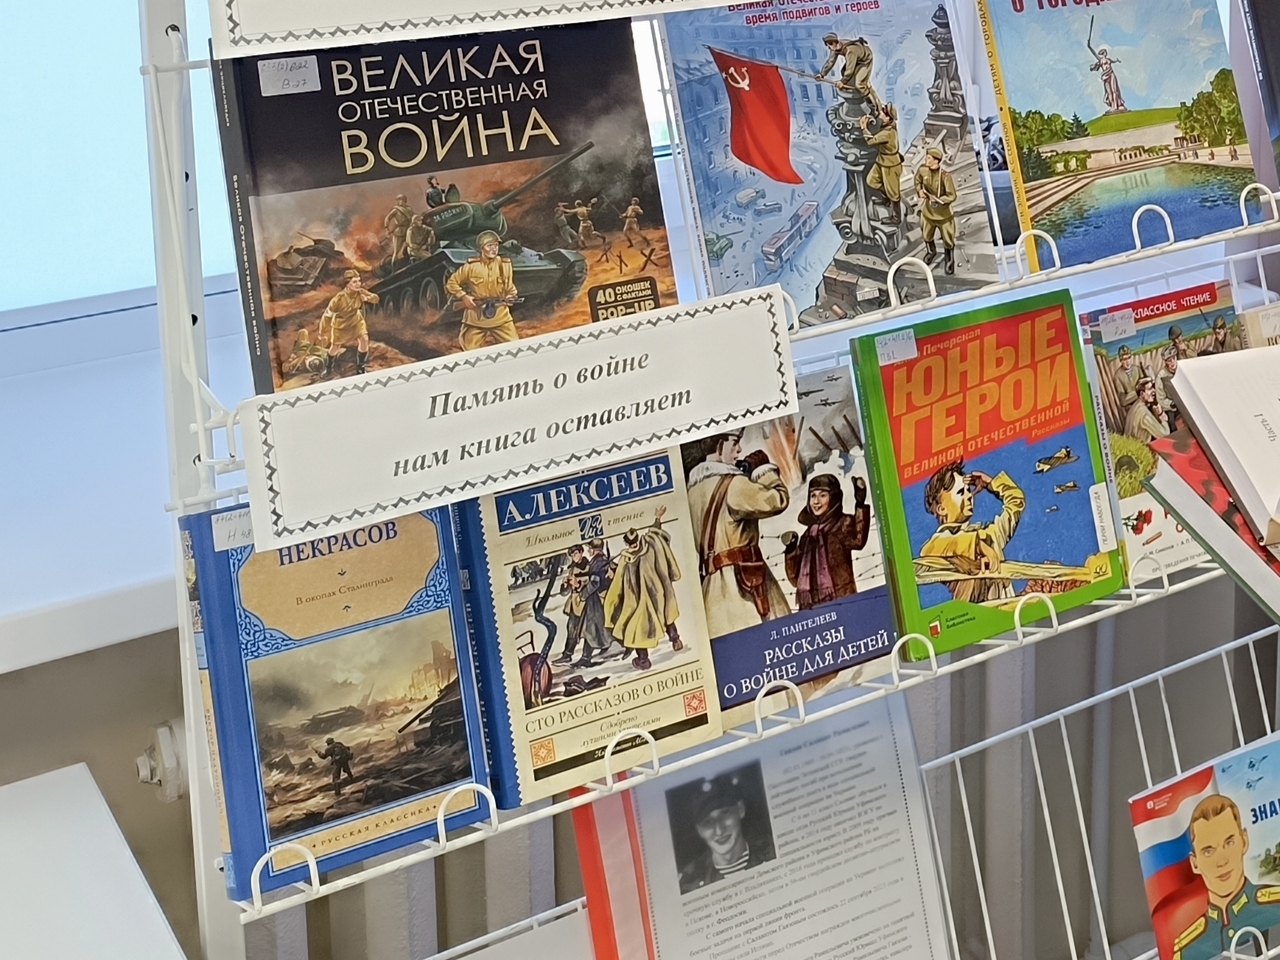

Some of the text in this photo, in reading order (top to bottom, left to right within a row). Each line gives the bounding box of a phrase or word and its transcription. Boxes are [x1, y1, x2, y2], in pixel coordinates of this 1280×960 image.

[745, 0, 880, 26] время подвигов и героев
[331, 40, 546, 96] ВЕЛИКАЯ
[986, 49, 993, 58] О
[988, 62, 1002, 96] ДЕТЯМ
[338, 79, 549, 124] ОТЕЧЕСТВЕННАЯ
[340, 107, 560, 175] ВОЙНА
[593, 278, 651, 305] 40 ОКОШЕК
[597, 296, 655, 322] POP-UP
[1132, 301, 1177, 319] КЛАССНОЕ
[1181, 291, 1211, 309] ЧТЕНИЕ
[893, 308, 1063, 417] ЮНЫЕ
[923, 329, 981, 357] Печерская
[428, 352, 650, 420] Память о войне
[900, 351, 1070, 465] ГЕРОИ
[1031, 418, 1070, 437] Рассказы
[393, 387, 692, 477] нам книга оставляет
[904, 401, 1070, 480] ВЕЛИКОЙ ОТЕЧЕСТВЕННОЙ
[1092, 395, 1115, 483] РАССКАЗЫ ВОЙНЕ
[1257, 418, 1276, 442] Часть
[503, 463, 668, 525] АЛЕКСЕЕВ
[277, 520, 398, 566] НЕКРАСОВ
[525, 510, 644, 548] Школьное чтение
[295, 575, 394, 606] В окопах Сталинграда
[764, 626, 845, 665] РАССКАЗЫ
[770, 611, 837, 640] Л. ПАНТЕЛЕЕВ
[724, 630, 888, 699] О ВОЙНЕ ДЛЯ ДЕТЕЙ
[526, 668, 704, 734] СТО РАССКАЗОВ О ВОЙНЕ
[320, 806, 431, 846] РУССКАЯ КЛАССИКА
